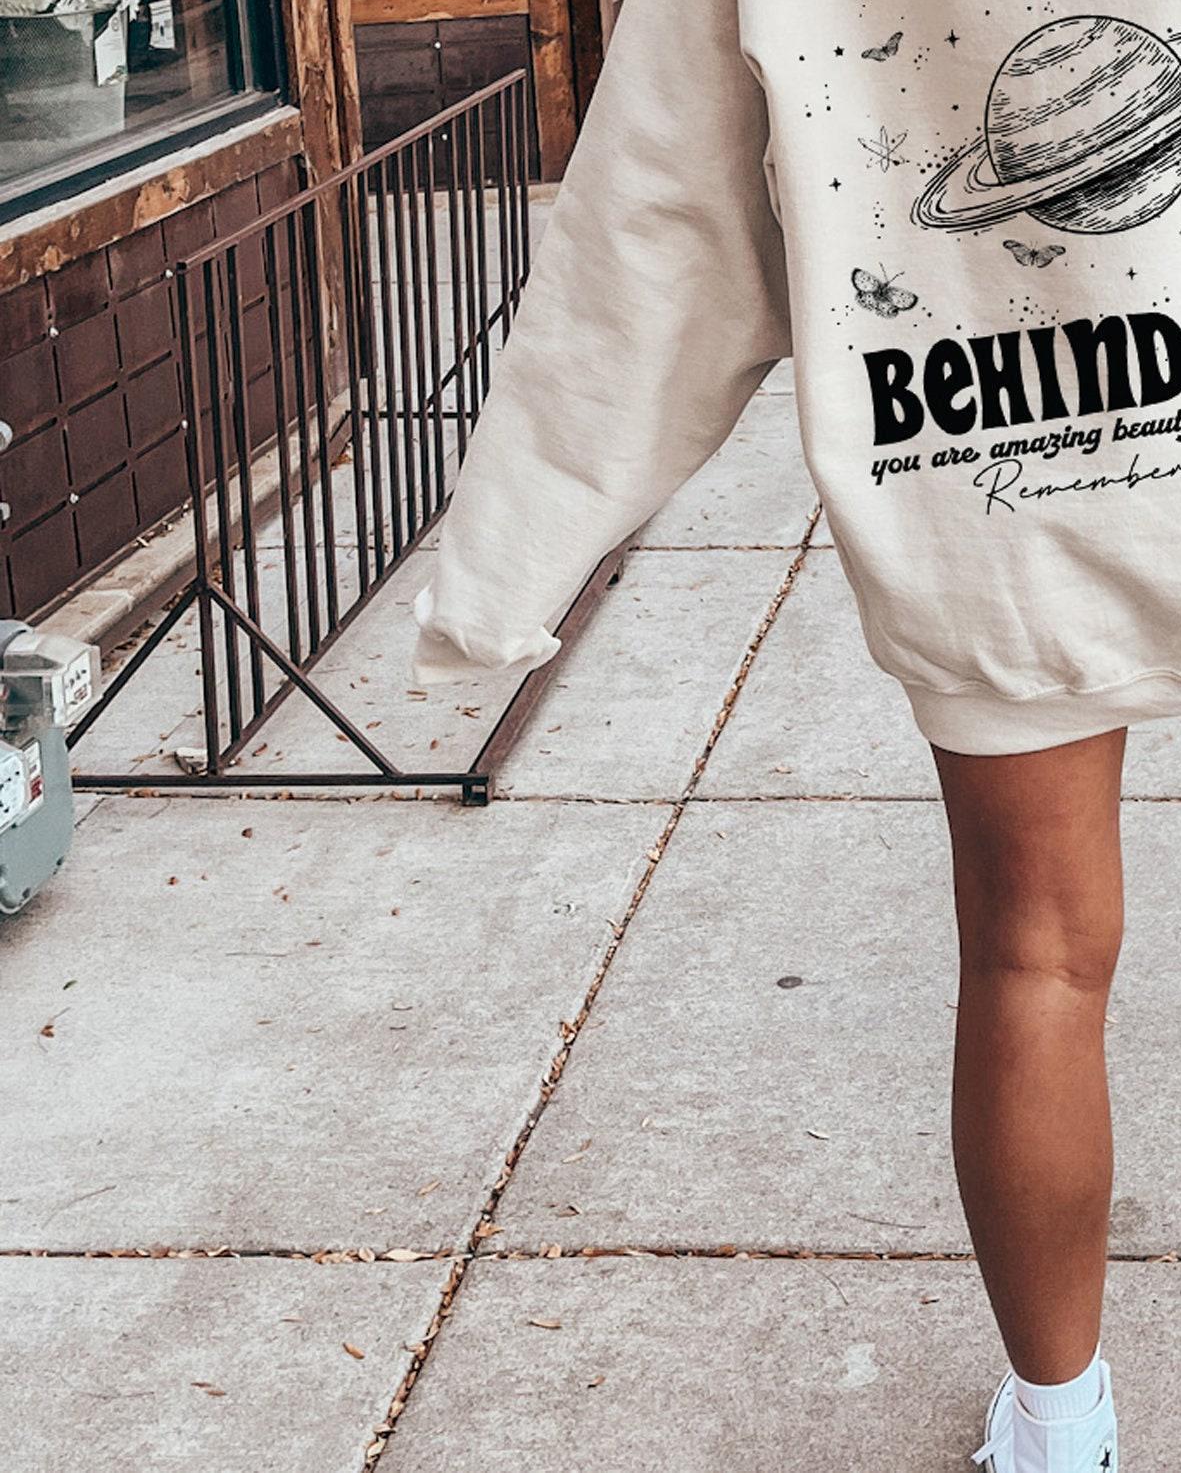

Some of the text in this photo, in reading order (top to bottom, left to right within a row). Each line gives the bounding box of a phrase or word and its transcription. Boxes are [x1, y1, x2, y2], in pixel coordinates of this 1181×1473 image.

[870, 453, 921, 486] you
[931, 446, 981, 469] are
[989, 427, 1103, 460] amazing
